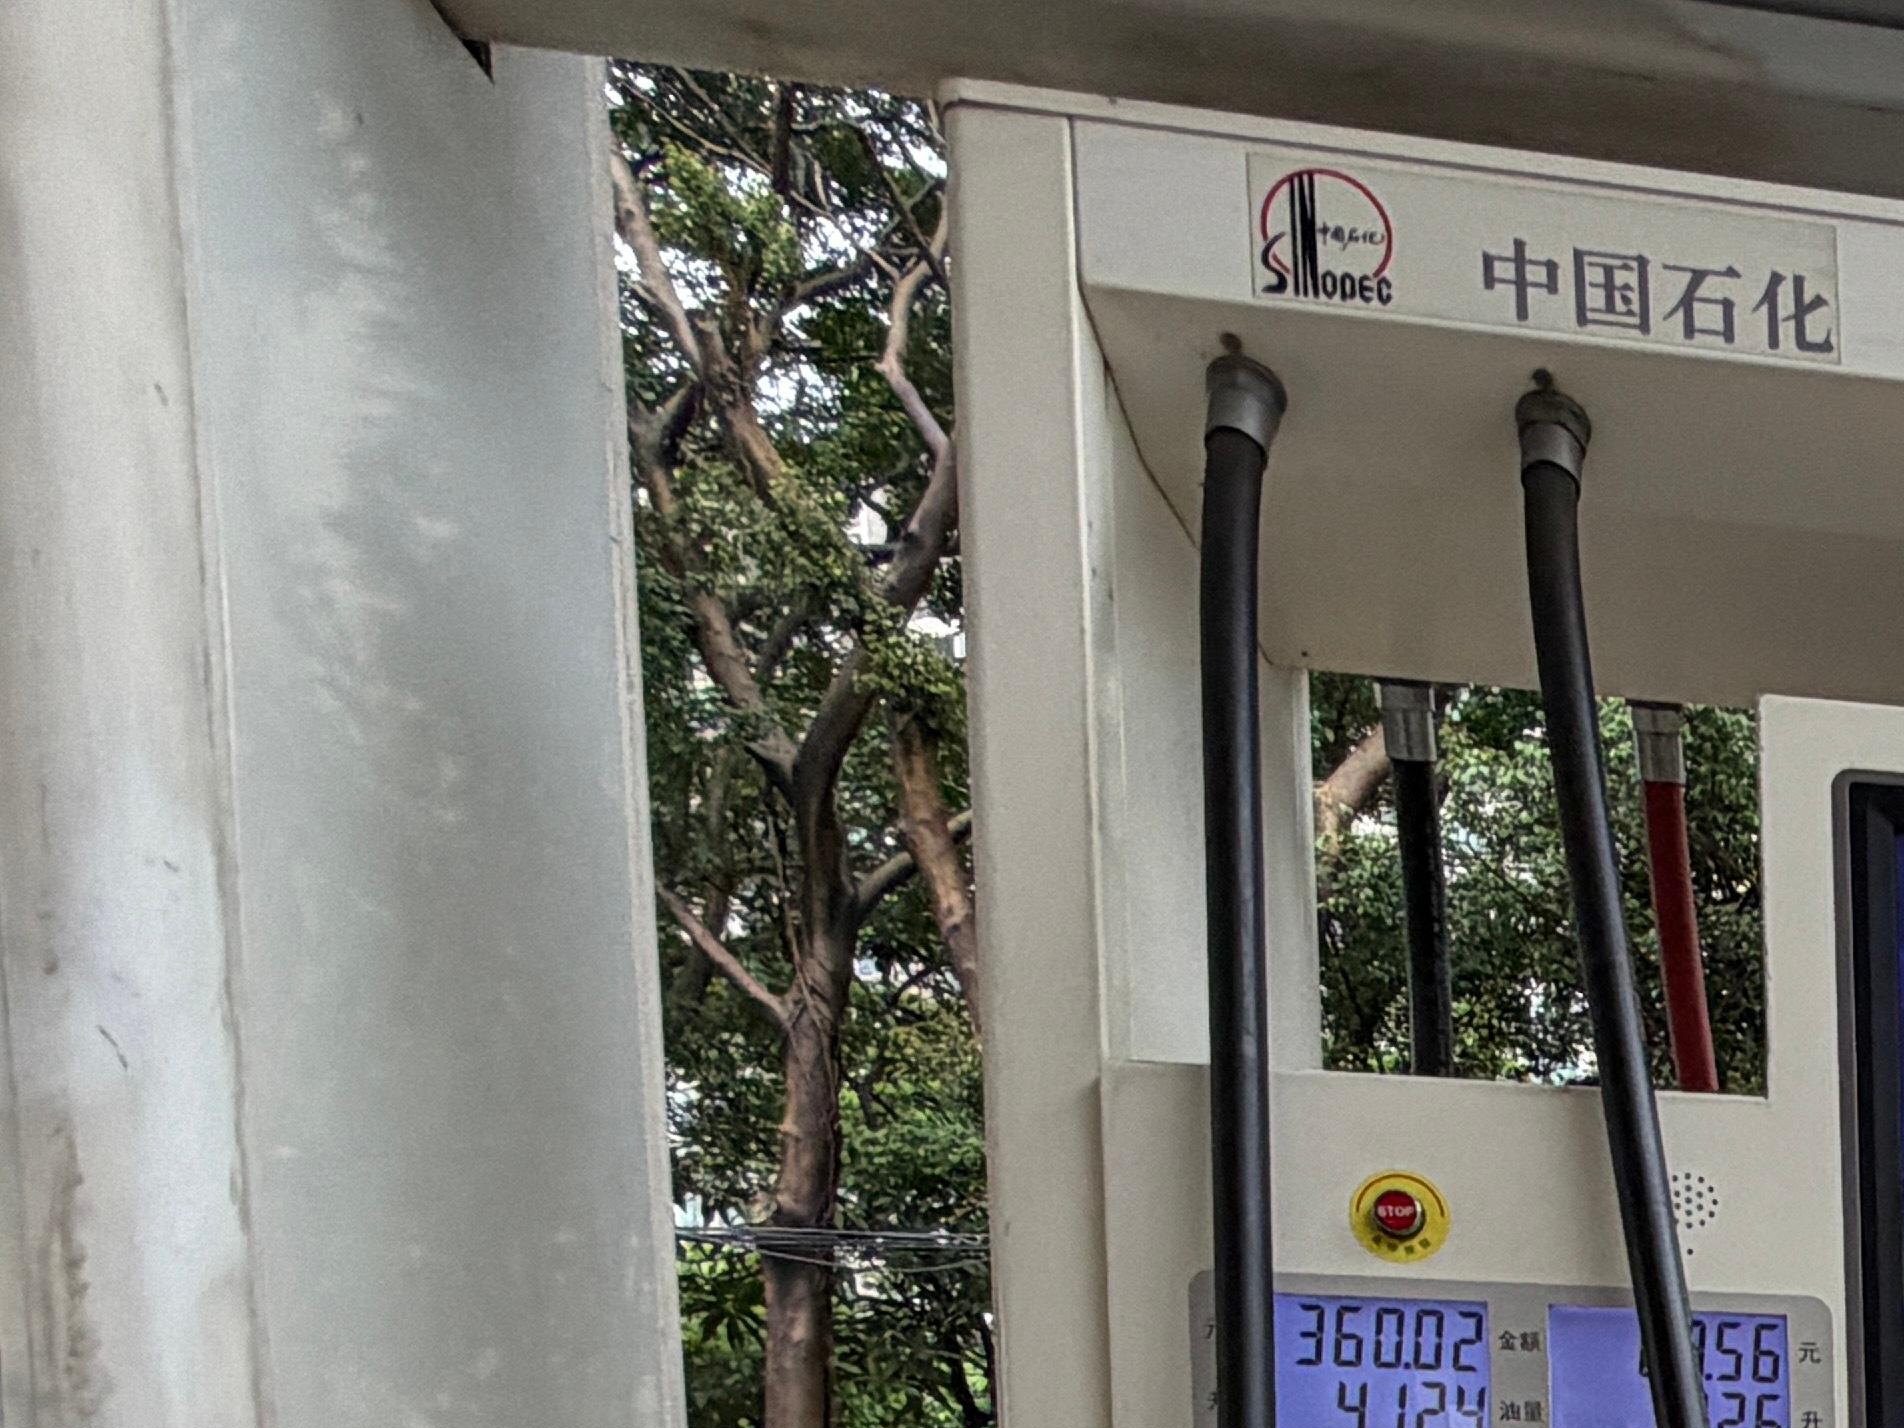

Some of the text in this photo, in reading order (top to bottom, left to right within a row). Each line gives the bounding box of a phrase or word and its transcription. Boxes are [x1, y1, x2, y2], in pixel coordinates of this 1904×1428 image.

[1482, 238, 1834, 354] 中国石化
[1377, 1205, 1414, 1218] STOP
[1297, 1303, 1484, 1372] 360.02
[1799, 1341, 1822, 1365] 元
